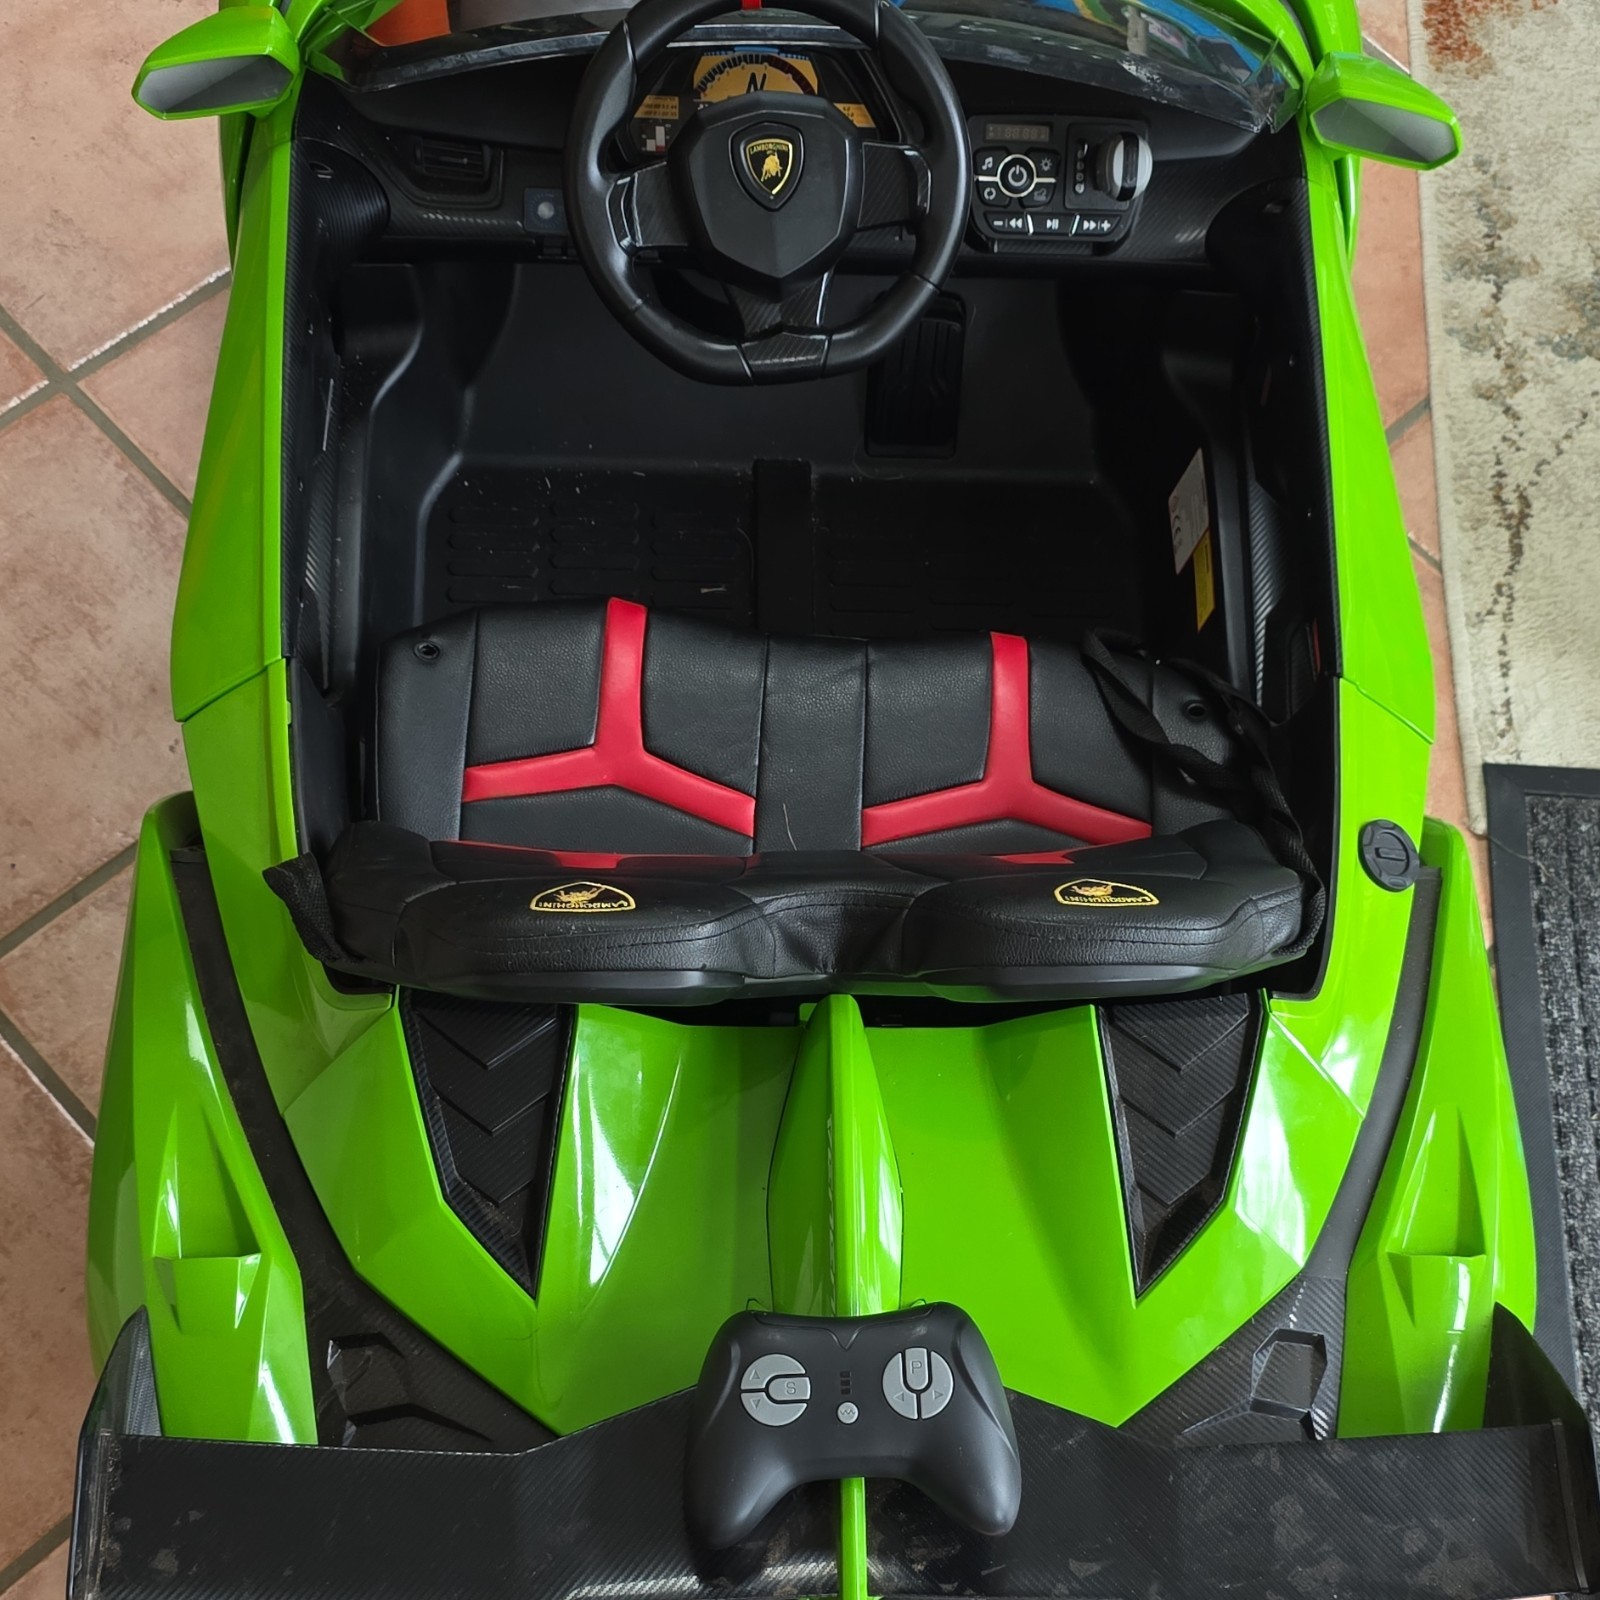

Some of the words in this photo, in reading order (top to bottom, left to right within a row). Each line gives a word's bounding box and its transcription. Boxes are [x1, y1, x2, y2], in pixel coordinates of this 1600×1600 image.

[749, 143, 789, 155] LAMBORGHINI
[911, 1360, 923, 1375] P
[785, 1381, 797, 1395] S
